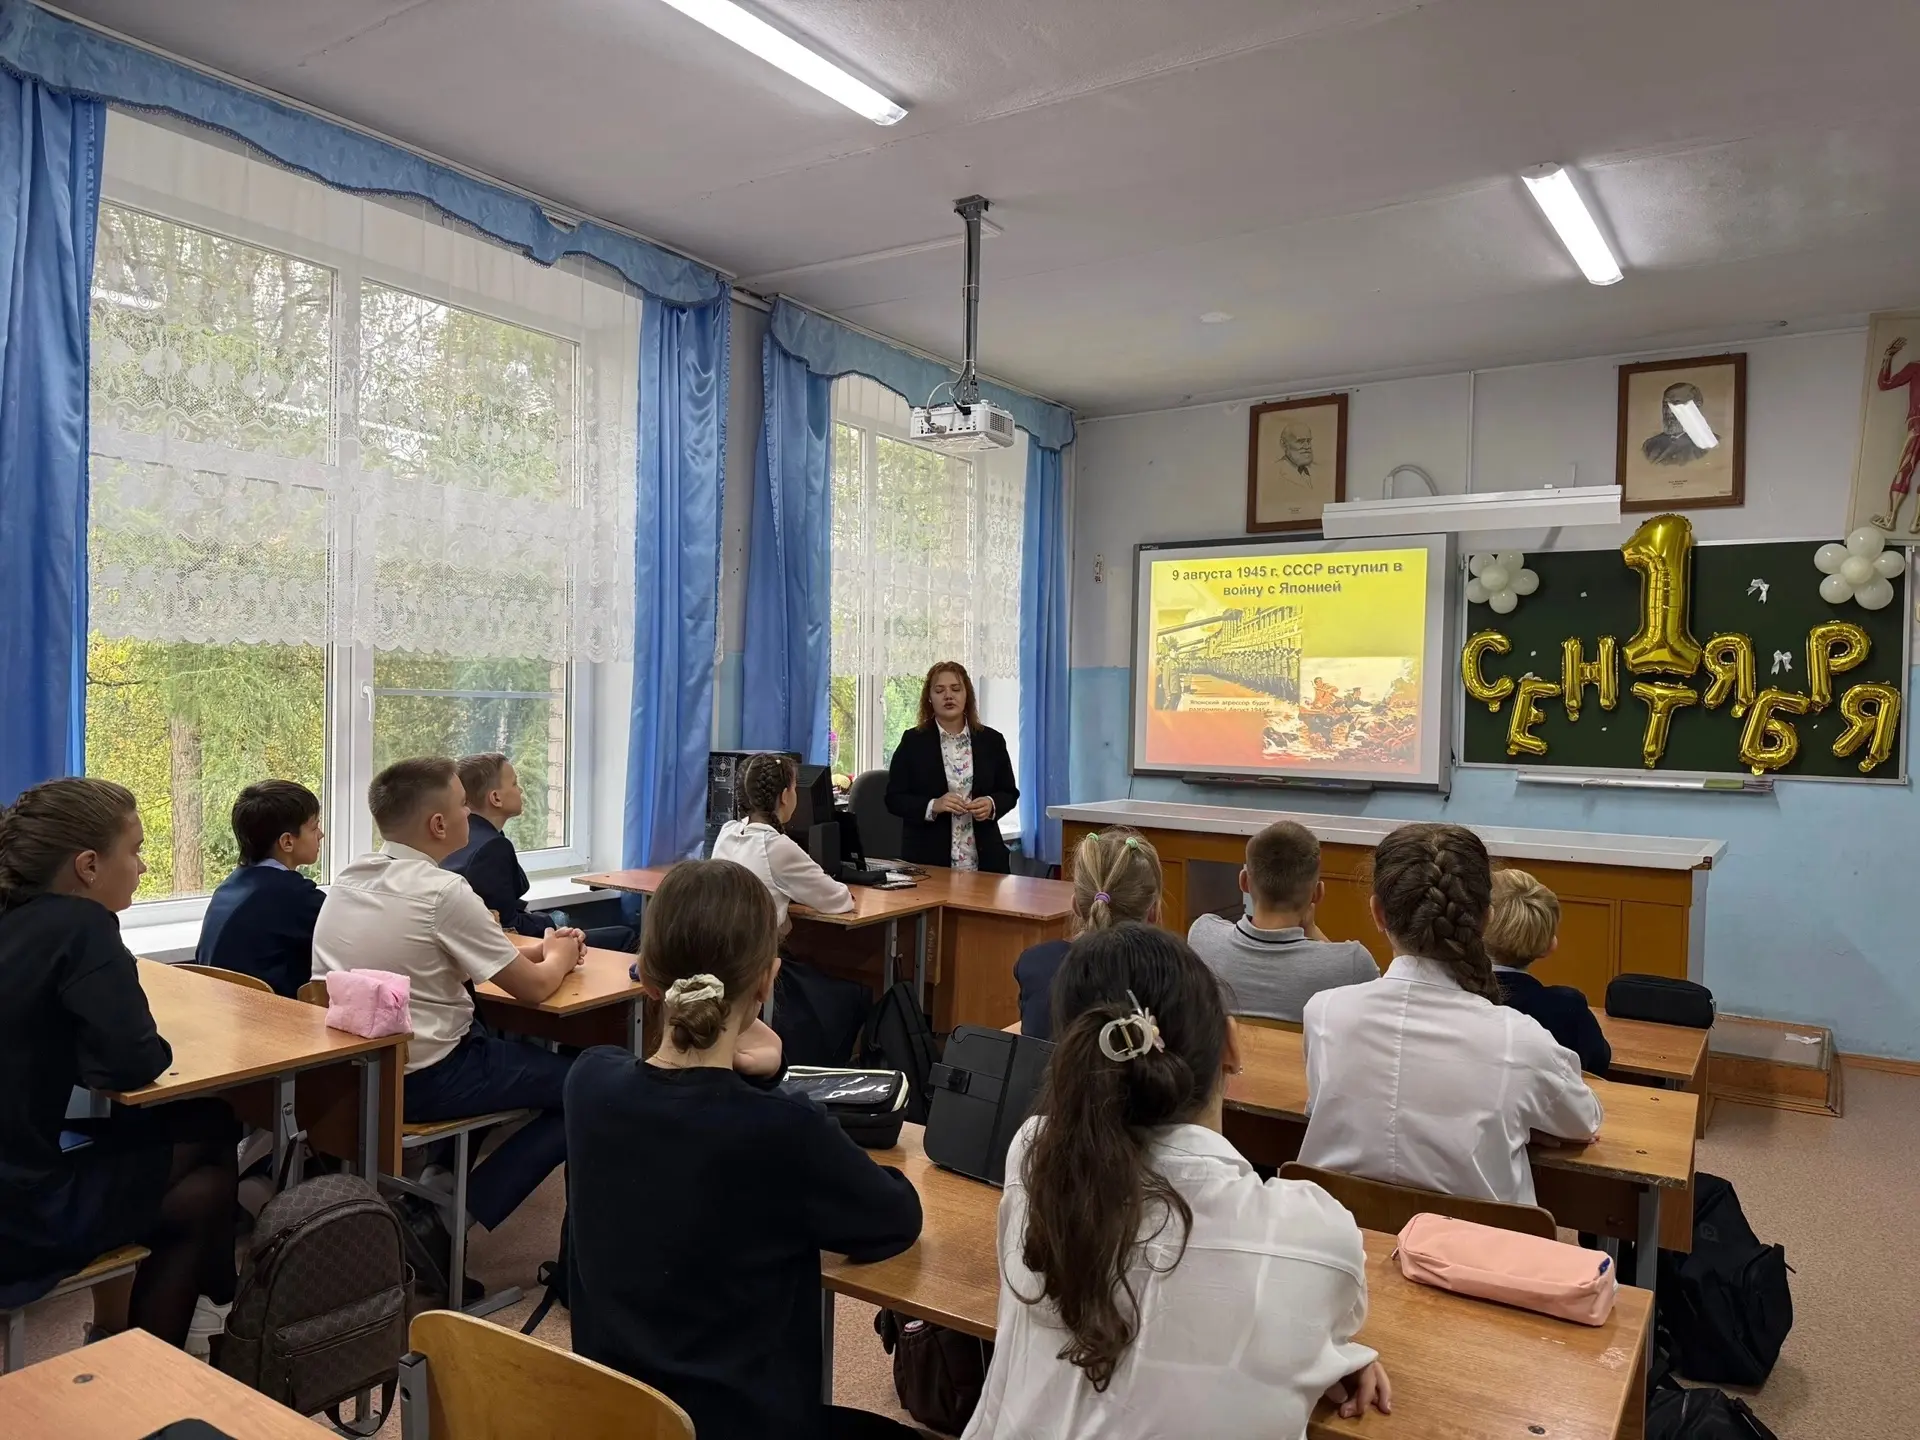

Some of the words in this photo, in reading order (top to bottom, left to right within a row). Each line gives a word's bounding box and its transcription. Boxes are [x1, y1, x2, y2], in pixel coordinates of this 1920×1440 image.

[1172, 569, 1180, 581] 9
[1183, 569, 1232, 582] августа
[1236, 566, 1267, 578] 1945
[1270, 567, 1278, 577] г.
[1282, 563, 1324, 576] СССР
[1327, 562, 1389, 577] вступил
[1393, 562, 1403, 572] в
[1223, 583, 1263, 597] войну
[1267, 585, 1275, 594] с
[1279, 580, 1341, 594] Японией
[1620, 513, 1701, 677] 1
